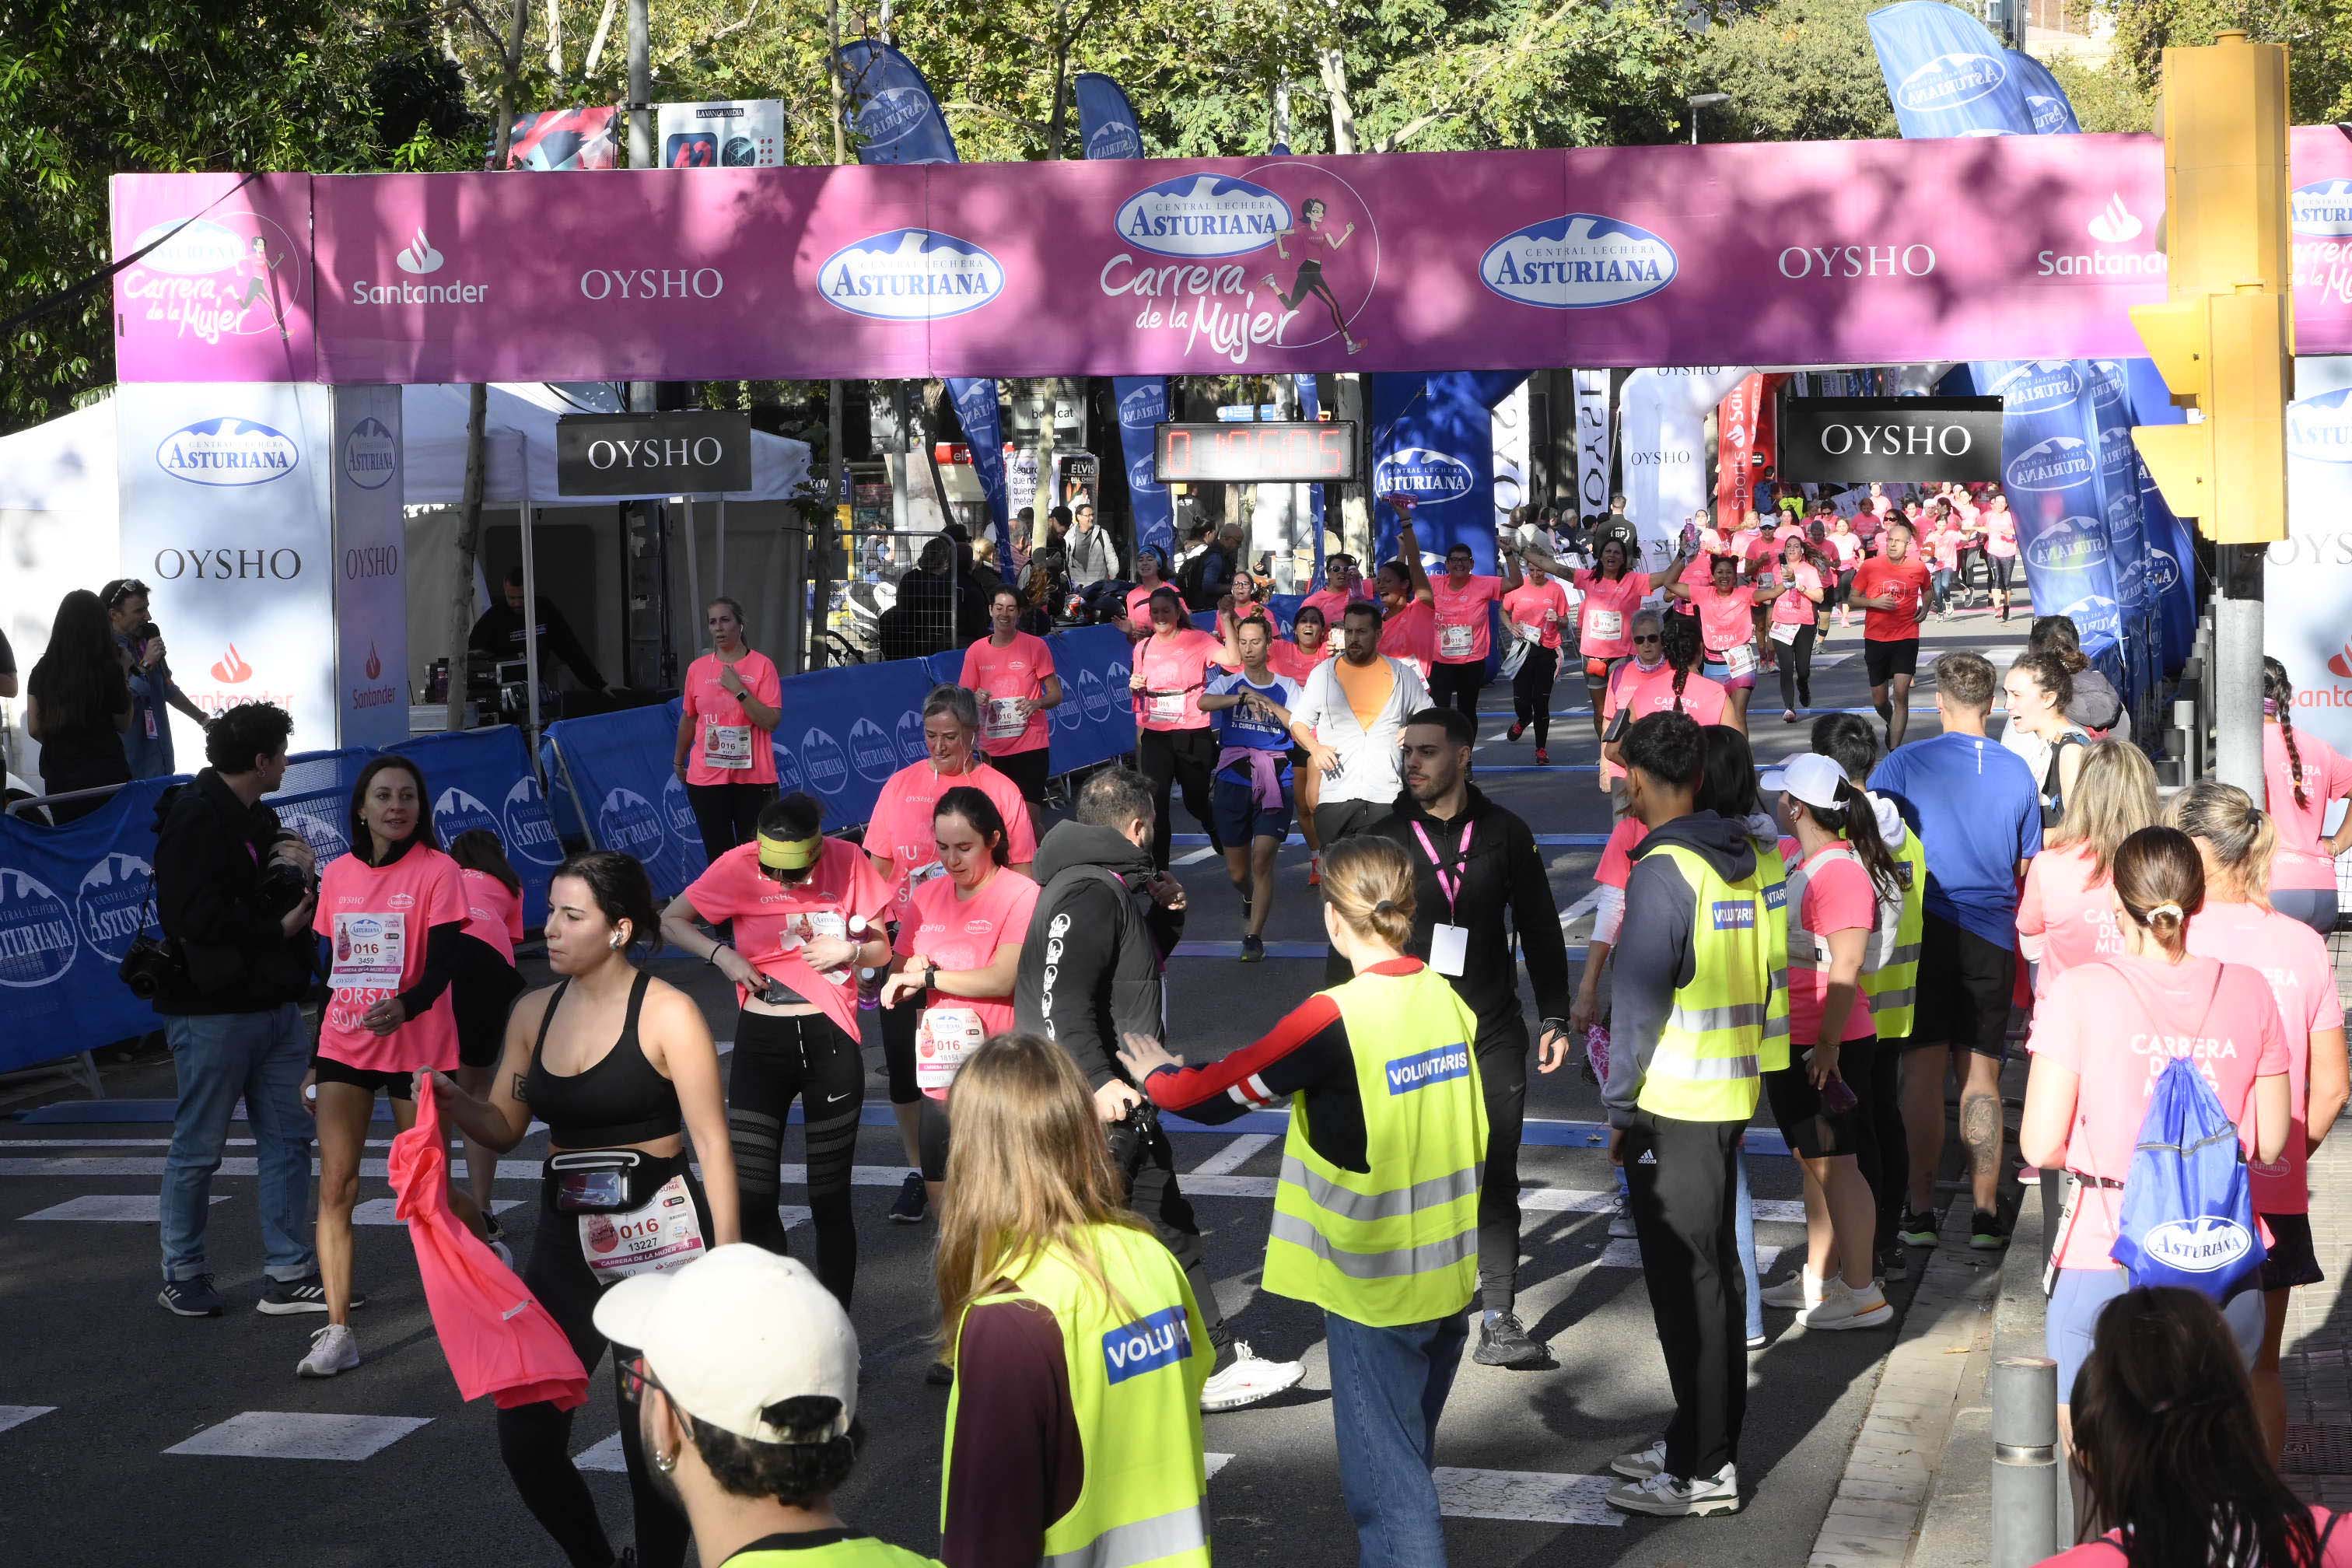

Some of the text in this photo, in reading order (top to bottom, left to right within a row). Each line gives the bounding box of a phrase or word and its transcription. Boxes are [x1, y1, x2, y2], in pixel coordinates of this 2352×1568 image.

[1155, 200, 1272, 212] CENTRAL LECHERA
[1128, 205, 1277, 237] ASTURIANA
[1524, 244, 1655, 257] CENTRAL LECHERA
[1778, 243, 1936, 278] OYSHO
[2037, 250, 2167, 276] Santand
[831, 262, 990, 297] ASTURIANA
[1100, 254, 1245, 297] Carrera
[1495, 250, 1663, 285] ASTURIANA
[124, 269, 217, 299] Carrera
[353, 279, 489, 306] Santander
[580, 268, 724, 300] OYSHO
[177, 296, 251, 344] Mujer
[1136, 292, 1300, 365] de la Mujer
[588, 436, 723, 469] OYSHO
[1821, 424, 1972, 456] OYSHO
[168, 443, 289, 469] ASTURIANA
[348, 446, 394, 472] ASTURIANA
[1070, 464, 1095, 474] ELVIS
[1631, 450, 1691, 466] OYSHO
[1013, 477, 1026, 485] que
[1377, 471, 1466, 493] ASTURIANA
[1731, 451, 1749, 510] Sports
[345, 544, 397, 581] OYSHO
[2266, 533, 2352, 566] OYS
[154, 548, 302, 580] OYSHO
[352, 686, 397, 710] Santander
[703, 713, 719, 724] TU
[853, 744, 895, 768] ASTURIANA
[511, 813, 554, 848] ASTUR
[897, 845, 919, 860] TU
[338, 896, 364, 905] OYSHO
[0, 919, 74, 961] TURIANA
[353, 943, 380, 954] 016
[358, 957, 375, 965] 3459
[937, 1040, 961, 1051] 016
[2130, 1033, 2238, 1059] CARRERA
[1389, 1052, 1468, 1086] VOLUNTARIS
[1637, 1157, 1657, 1165] adidas
[620, 1218, 660, 1240] 016
[600, 1257, 633, 1268] CARRERA
[644, 1252, 654, 1261] LA
[654, 1247, 677, 1258] MUJER
[628, 1237, 658, 1252] 13227
[2154, 1234, 2242, 1258] ASTURIANA
